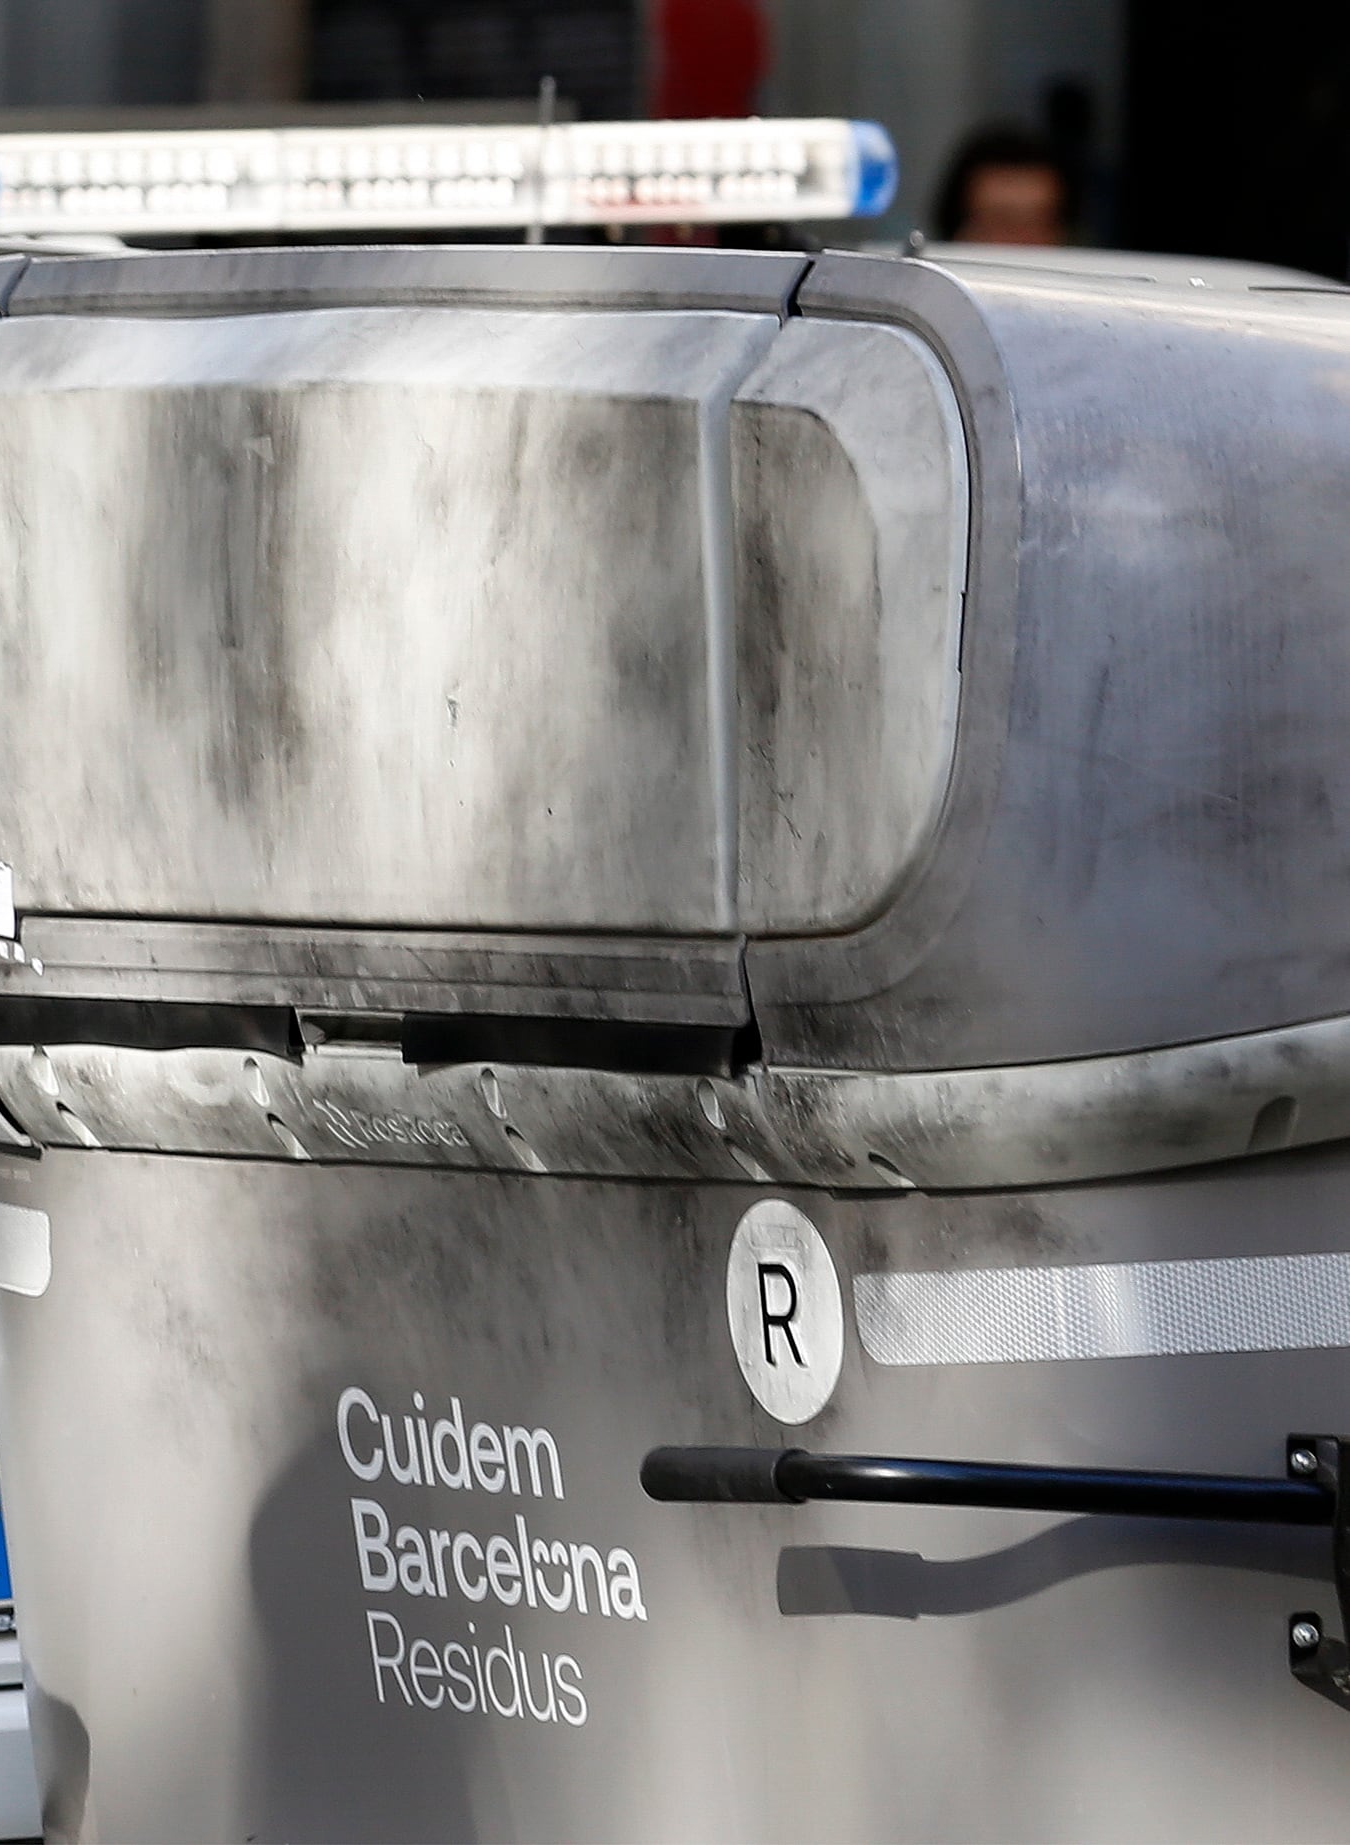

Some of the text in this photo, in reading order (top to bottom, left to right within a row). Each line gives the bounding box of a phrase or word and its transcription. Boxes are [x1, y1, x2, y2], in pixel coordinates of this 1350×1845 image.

[757, 1262, 808, 1368] R
[337, 1386, 565, 1500] Cuidem
[351, 1497, 648, 1621] Barcelona
[366, 1610, 590, 1727] Residus
